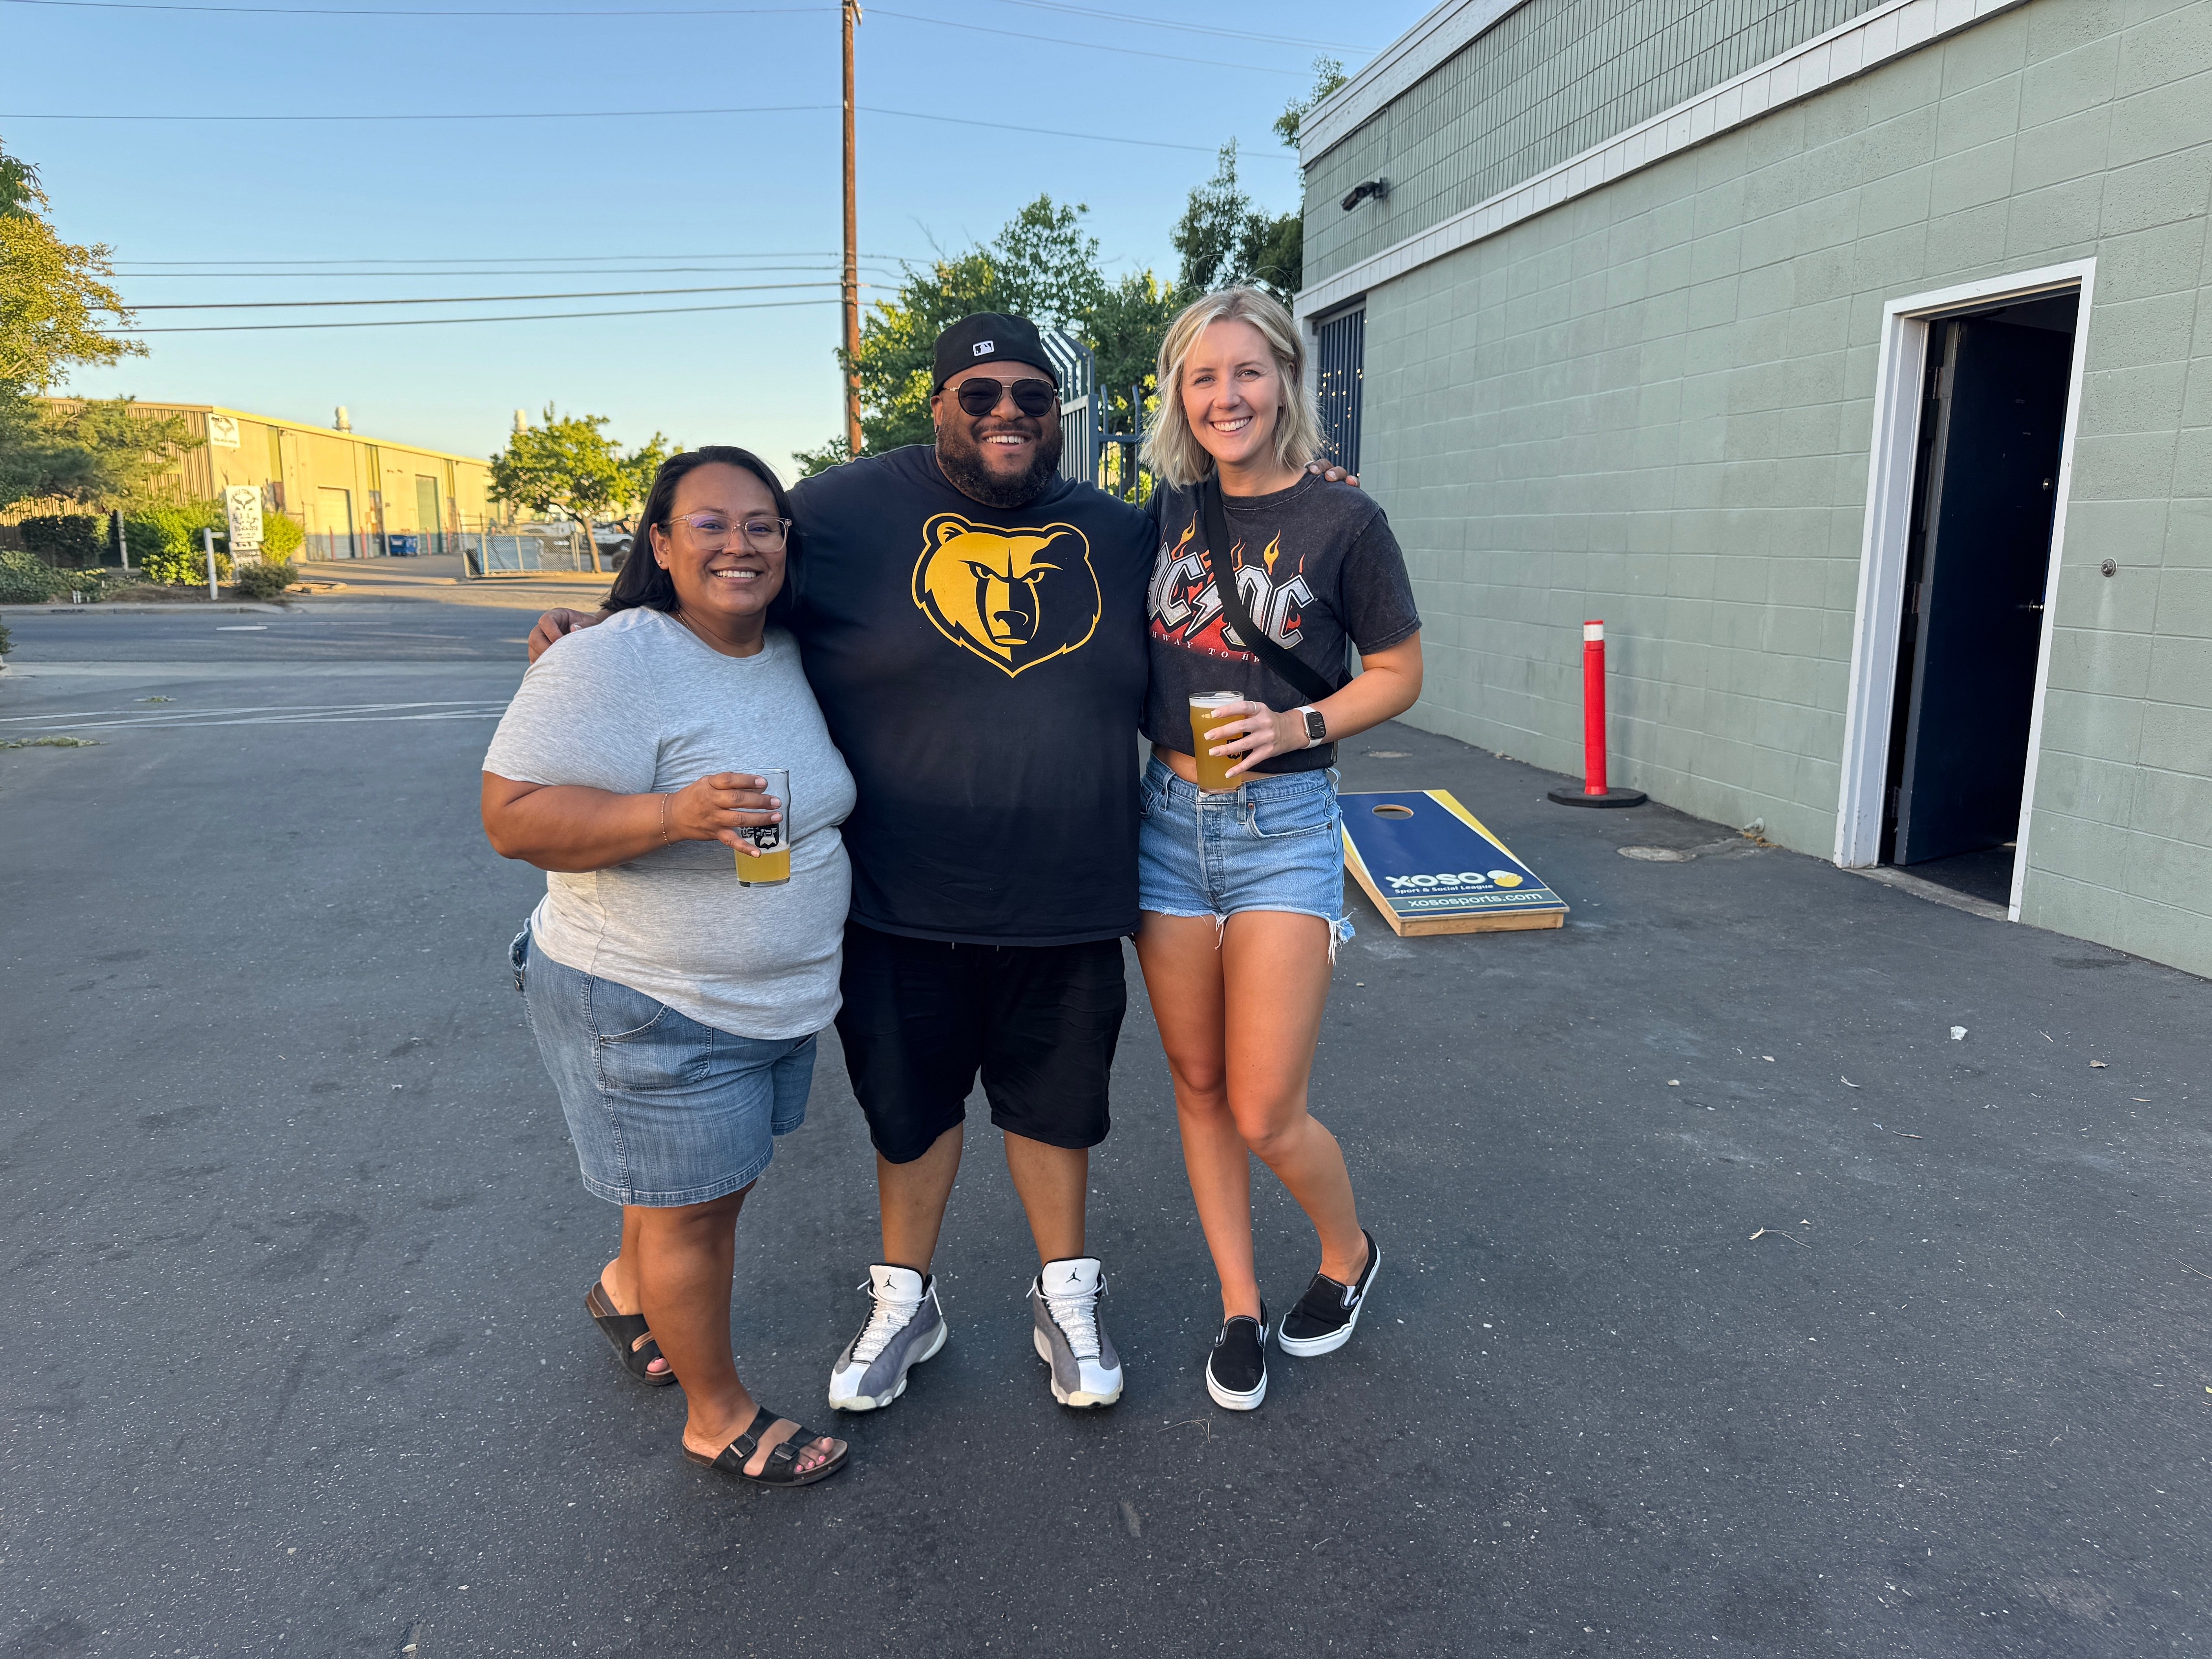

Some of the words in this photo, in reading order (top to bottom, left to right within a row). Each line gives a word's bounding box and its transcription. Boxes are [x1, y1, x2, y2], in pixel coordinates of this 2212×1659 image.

[1152, 631, 1193, 648] HWAY
[1208, 647, 1228, 658] TO
[1242, 653, 1260, 663] HE
[1408, 892, 1543, 907] xososports.com
